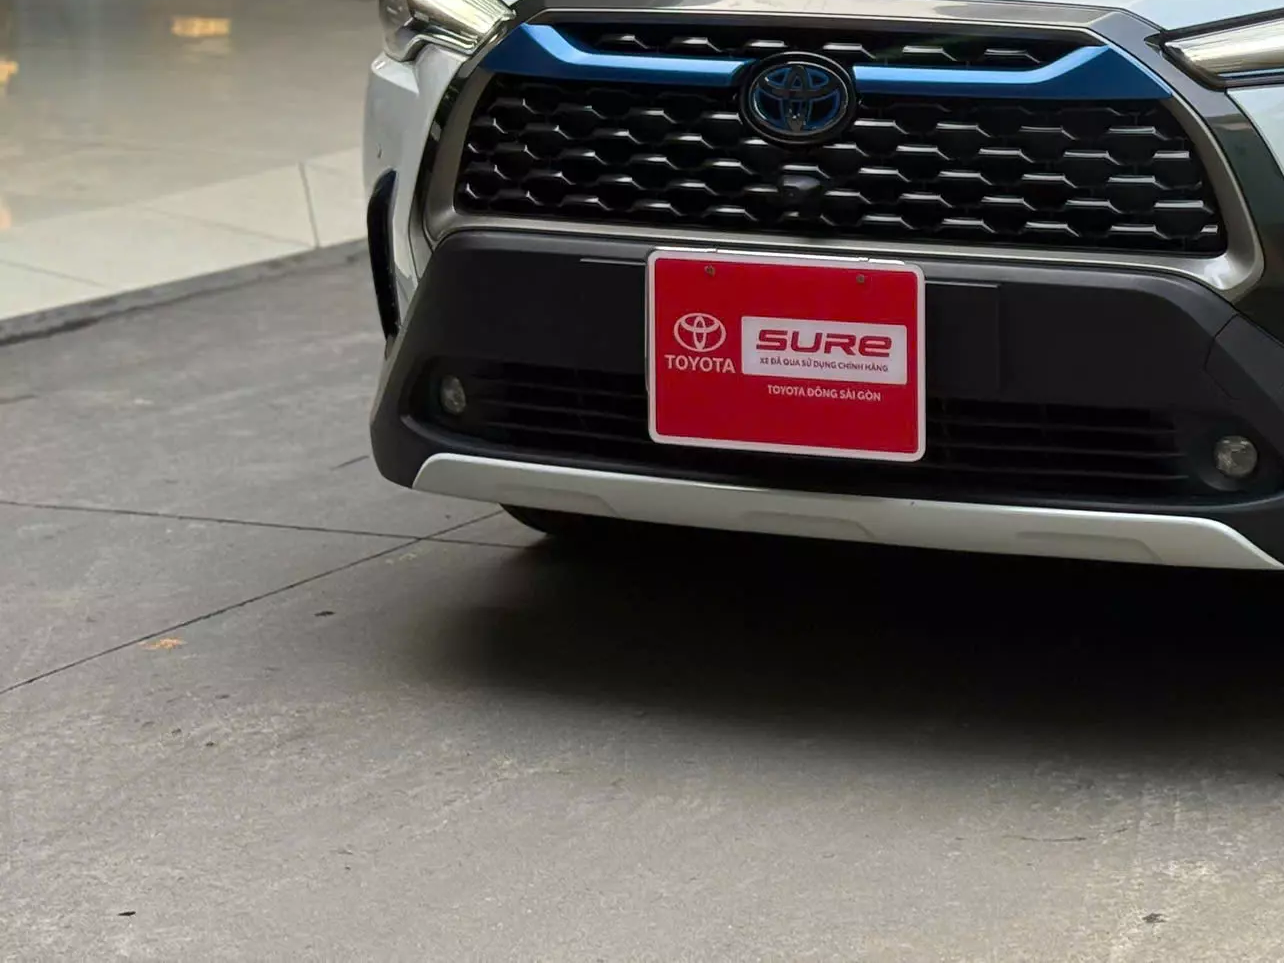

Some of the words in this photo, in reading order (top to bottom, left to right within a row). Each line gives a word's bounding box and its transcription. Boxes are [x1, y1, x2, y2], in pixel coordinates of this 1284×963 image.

[665, 355, 736, 374] TOYOTA
[760, 357, 769, 365] XE
[770, 356, 782, 366] ĐÃ
[783, 358, 800, 368] QUA
[767, 384, 806, 397] TOYOTA
[807, 385, 838, 399] ĐÔNG
[840, 387, 855, 400] SÀI
[857, 389, 881, 402] GÒN
